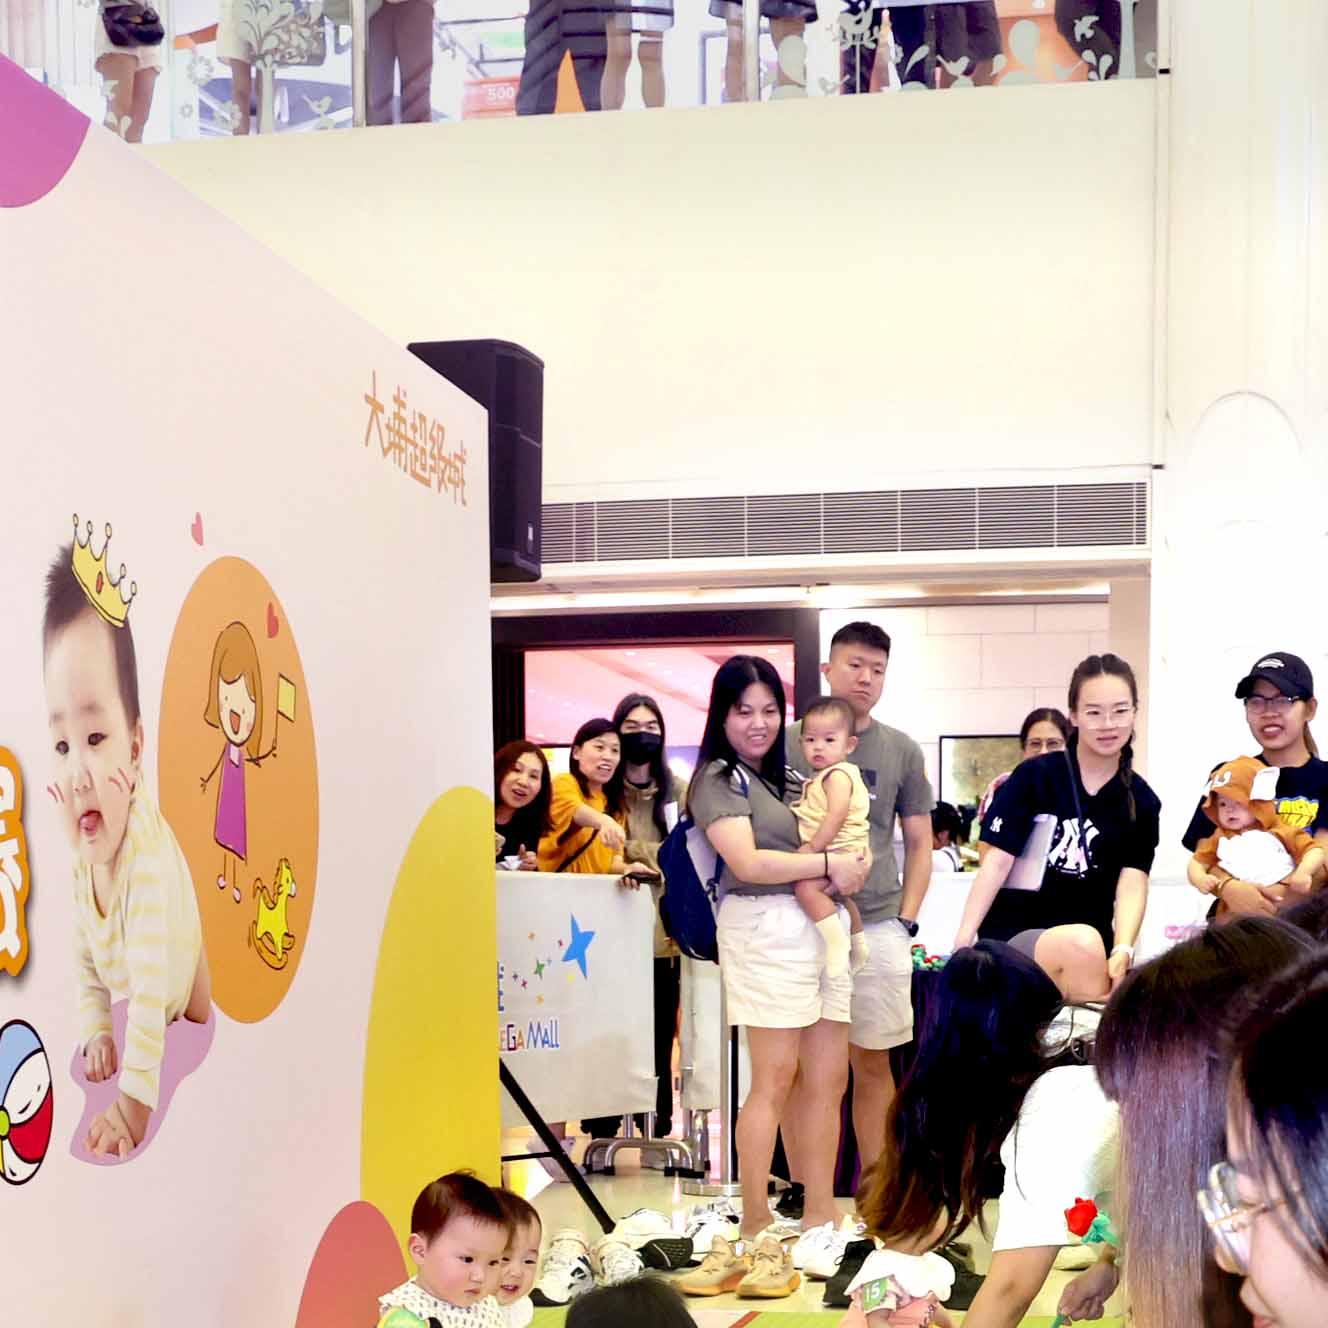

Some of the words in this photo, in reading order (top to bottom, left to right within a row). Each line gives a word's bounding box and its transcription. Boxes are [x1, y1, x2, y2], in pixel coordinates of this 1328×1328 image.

[364, 369, 467, 506] 大埔超級城
[499, 1024, 525, 1051] EGA
